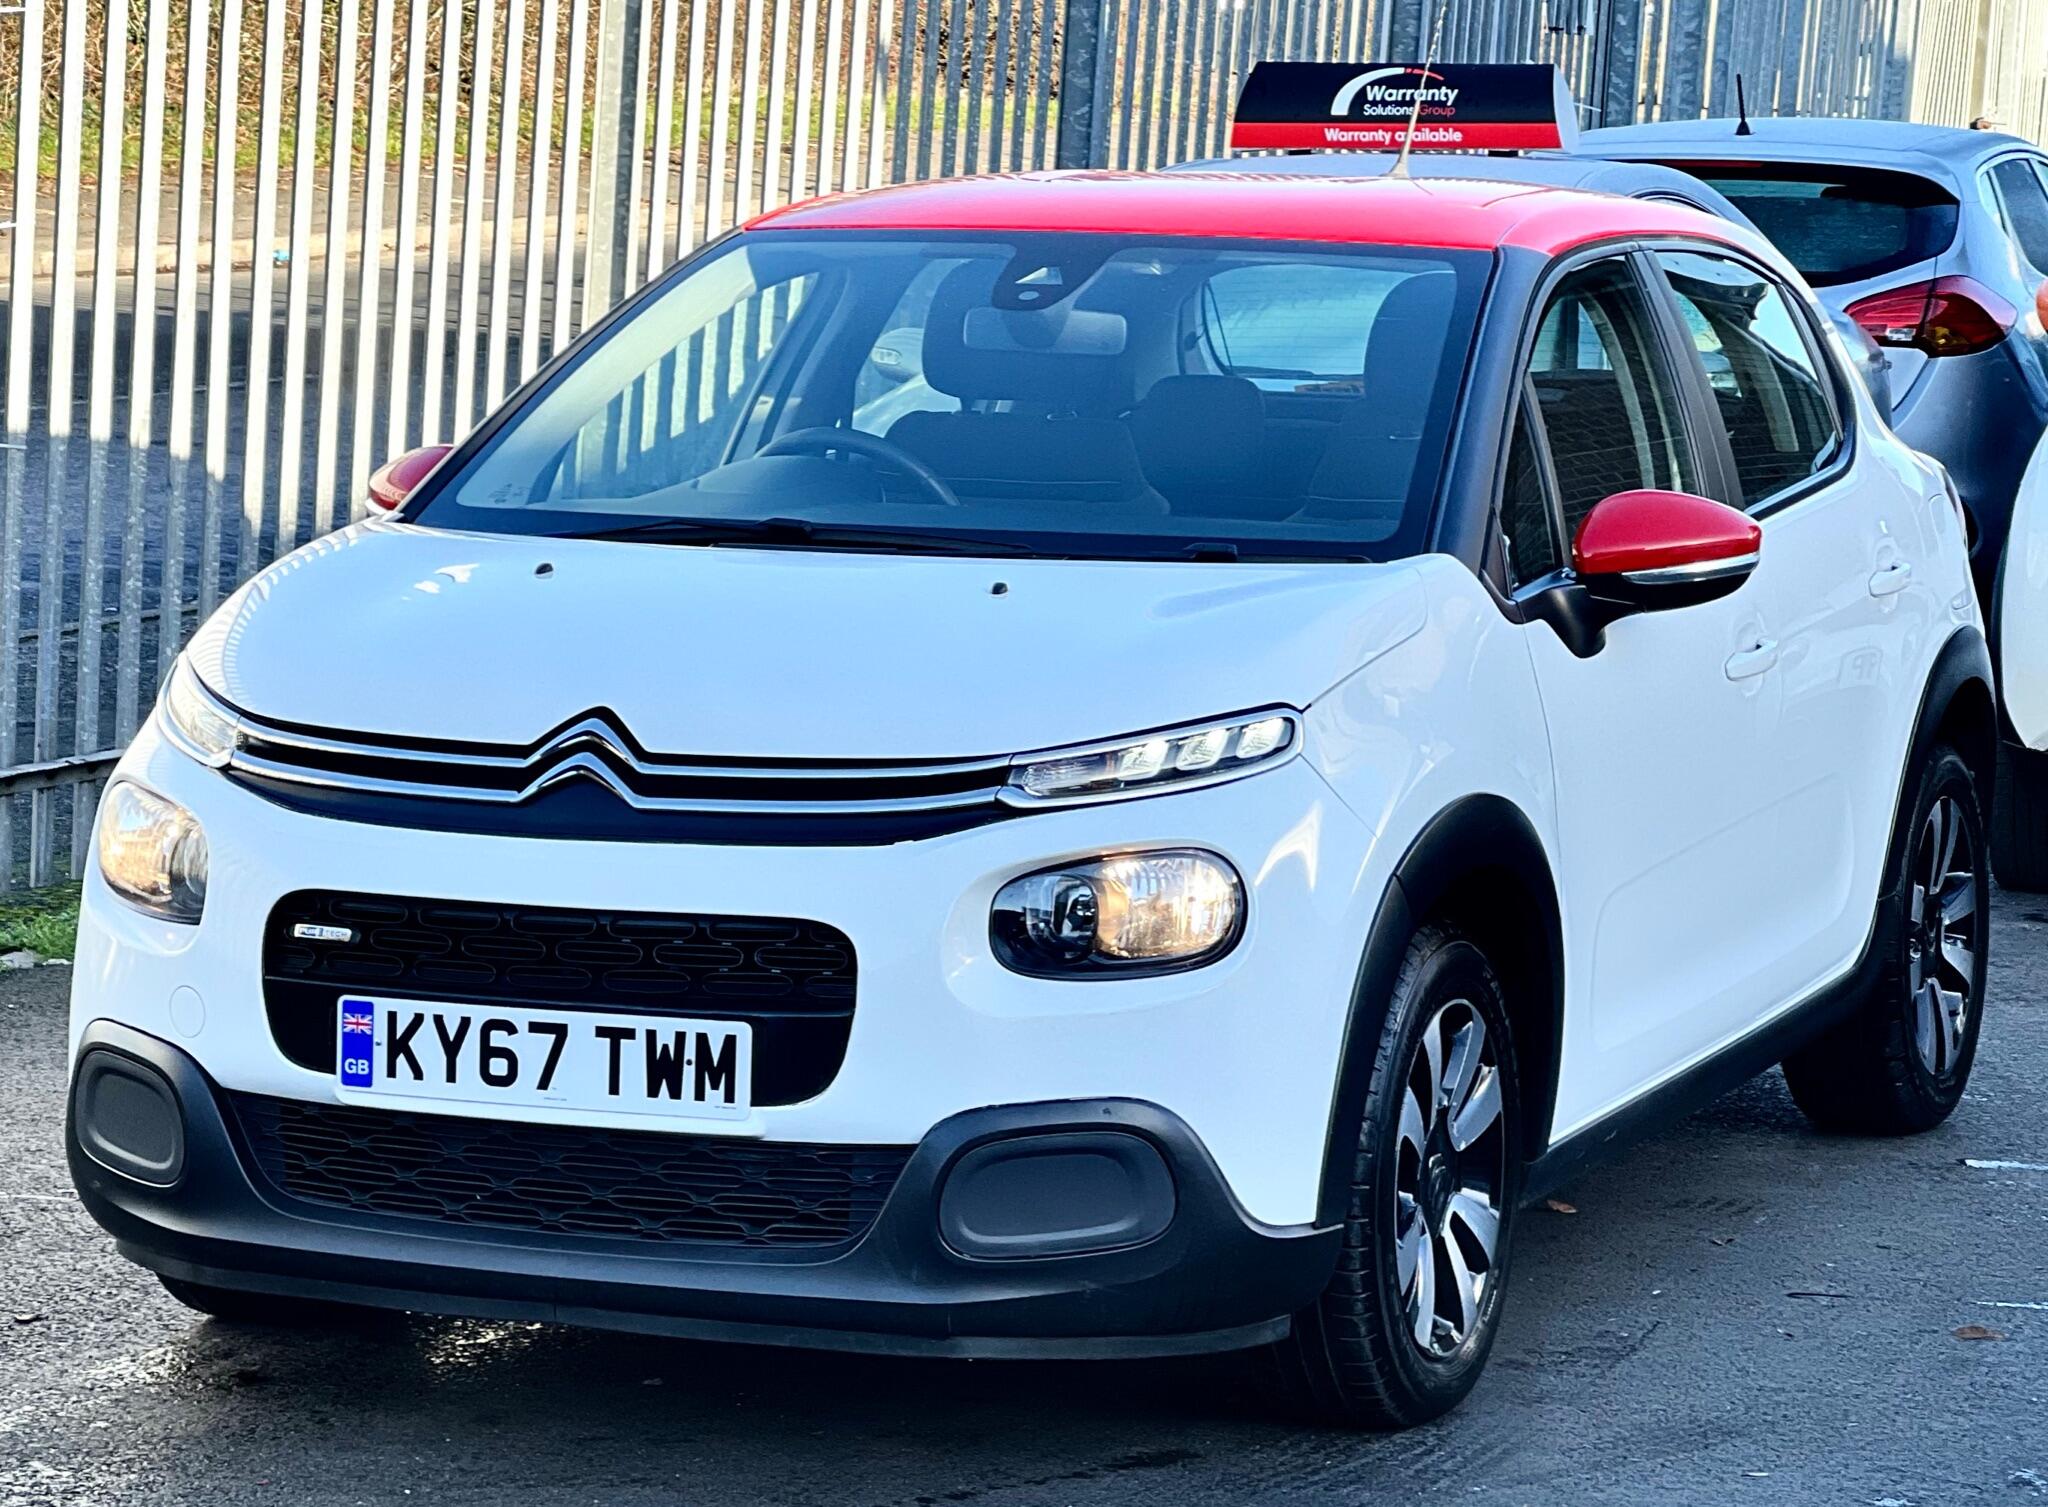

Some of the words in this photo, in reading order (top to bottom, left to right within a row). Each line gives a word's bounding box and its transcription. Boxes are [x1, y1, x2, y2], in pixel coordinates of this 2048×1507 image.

[1366, 85, 1459, 106] Warranty
[1363, 104, 1414, 116] Solutions
[1418, 105, 1456, 118] Group
[1324, 128, 1392, 145] Warranty
[1394, 128, 1463, 142] aailable
[386, 1010, 569, 1091] KY67
[595, 1025, 738, 1104] TWM
[344, 1058, 370, 1076] GB
